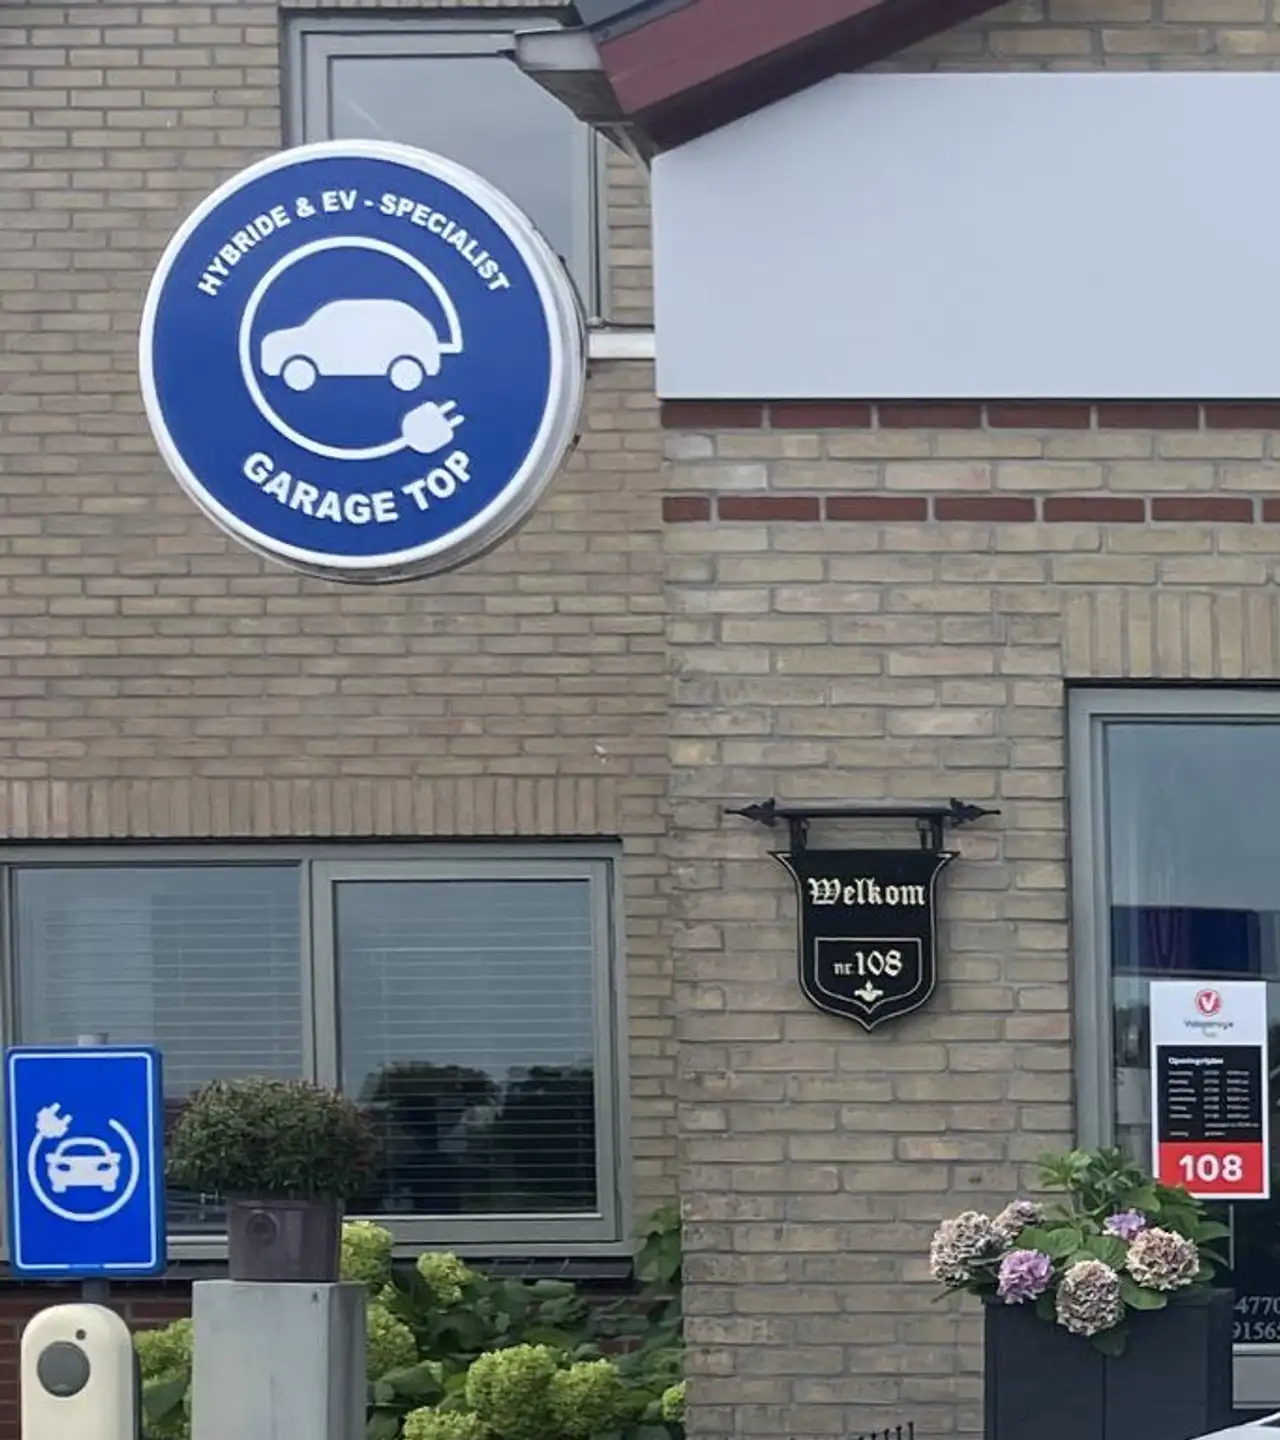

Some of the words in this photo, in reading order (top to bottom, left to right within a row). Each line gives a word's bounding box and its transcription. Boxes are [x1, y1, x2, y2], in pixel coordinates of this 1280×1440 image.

[197, 204, 291, 297] HYBRIDE
[295, 196, 316, 218] &
[321, 189, 358, 214] EV
[379, 193, 511, 293] SPECIALIST
[242, 451, 400, 525] GARAGE
[401, 450, 473, 512] TOP
[807, 877, 926, 906] Welkom
[854, 949, 903, 977] 108
[1178, 1153, 1244, 1183] 108
